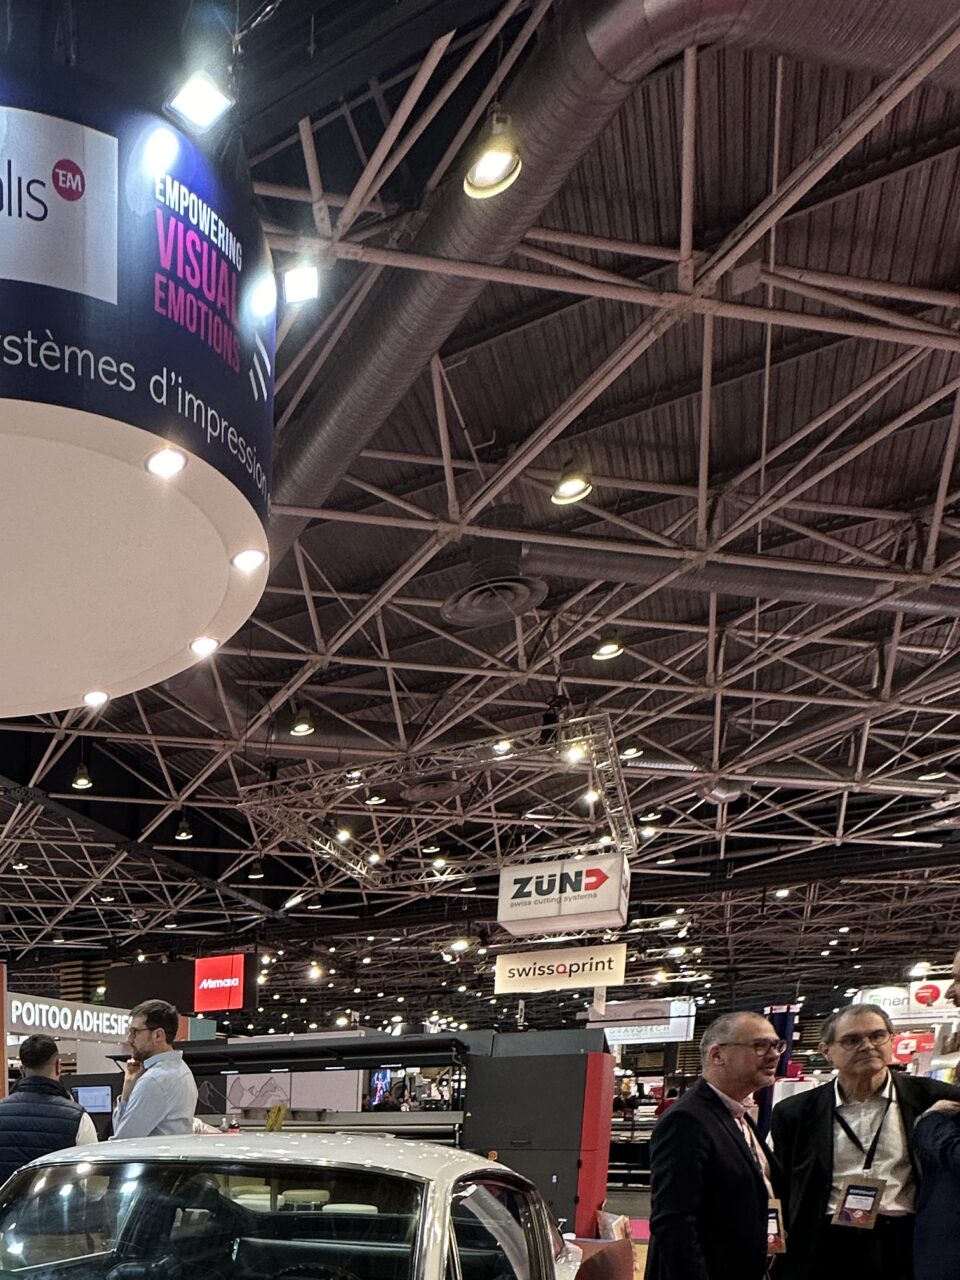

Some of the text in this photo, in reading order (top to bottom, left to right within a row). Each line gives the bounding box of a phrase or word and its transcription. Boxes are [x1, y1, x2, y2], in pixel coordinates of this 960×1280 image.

[154, 172, 242, 272] EMPOWERING
[155, 208, 240, 330] VISUAL
[154, 272, 241, 374] EMOTIONS
[11, 1000, 72, 1030] POITOO
